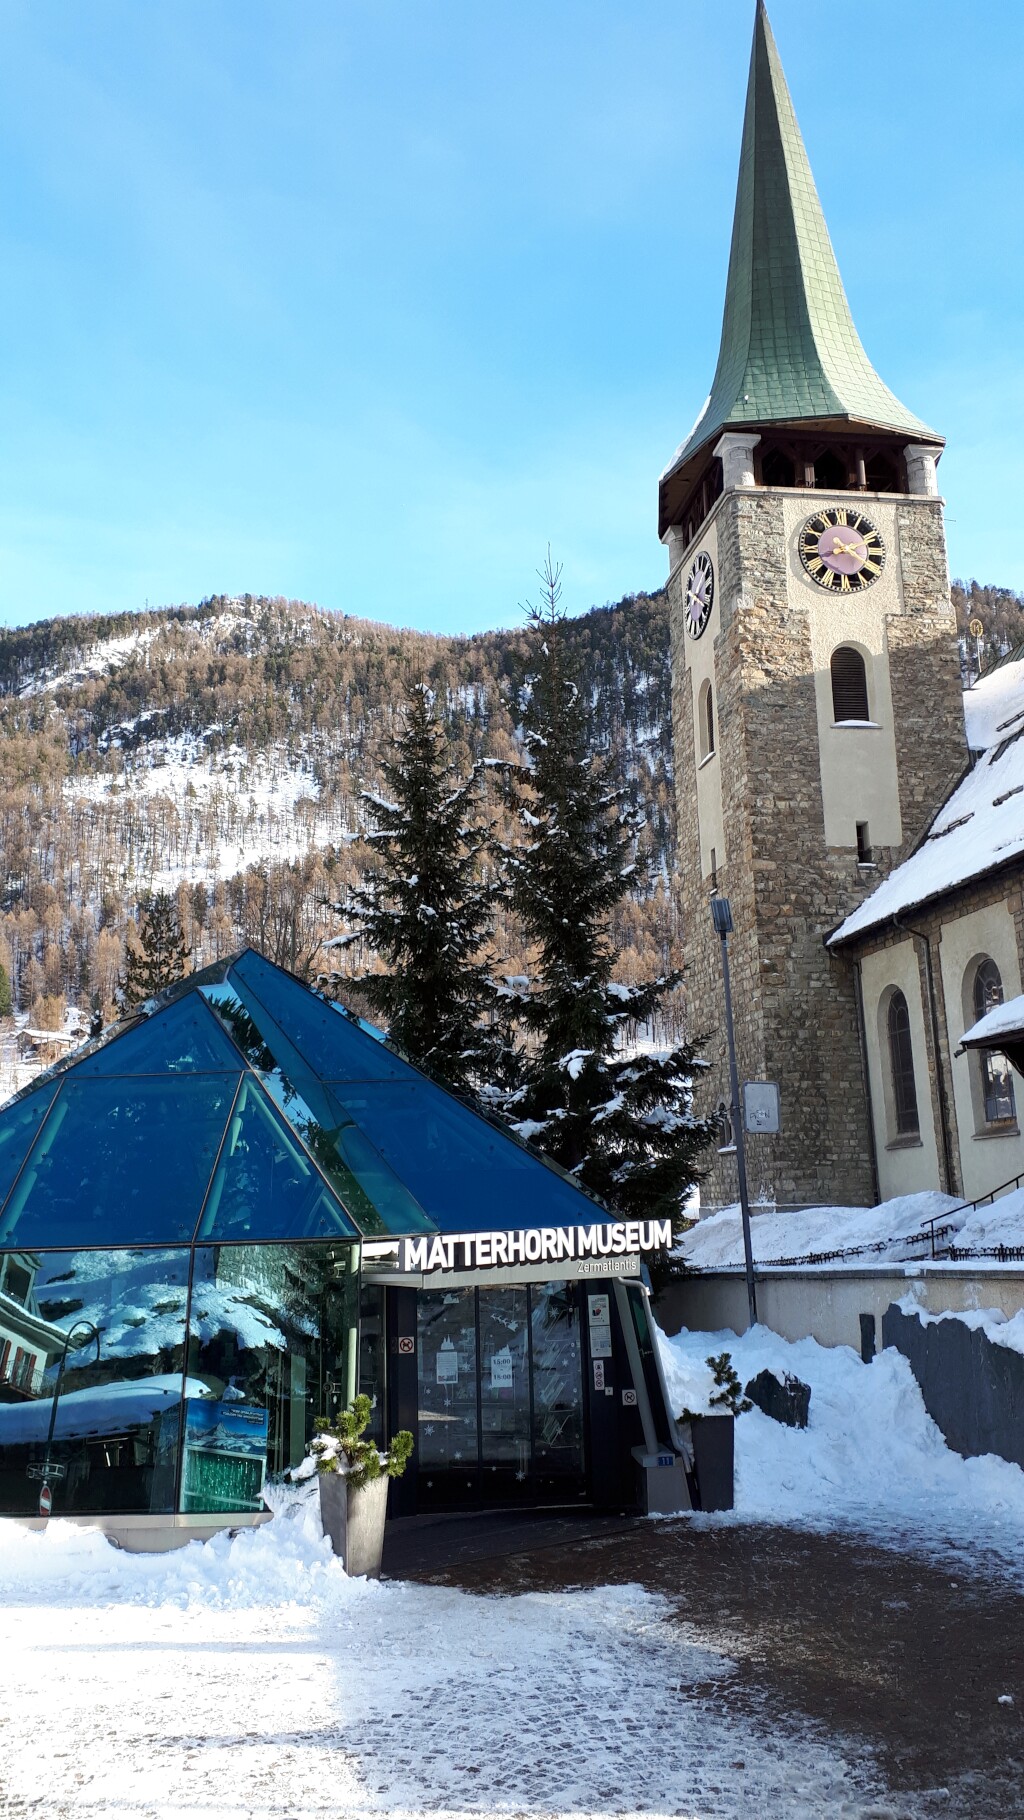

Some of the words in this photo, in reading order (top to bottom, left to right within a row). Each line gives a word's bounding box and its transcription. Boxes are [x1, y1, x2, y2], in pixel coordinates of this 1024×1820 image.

[404, 1227, 574, 1271] MATTERHORN
[576, 1219, 672, 1256] MUSEUM
[577, 1258, 637, 1273] Zermatlantis
[661, 1457, 670, 1465] 11
